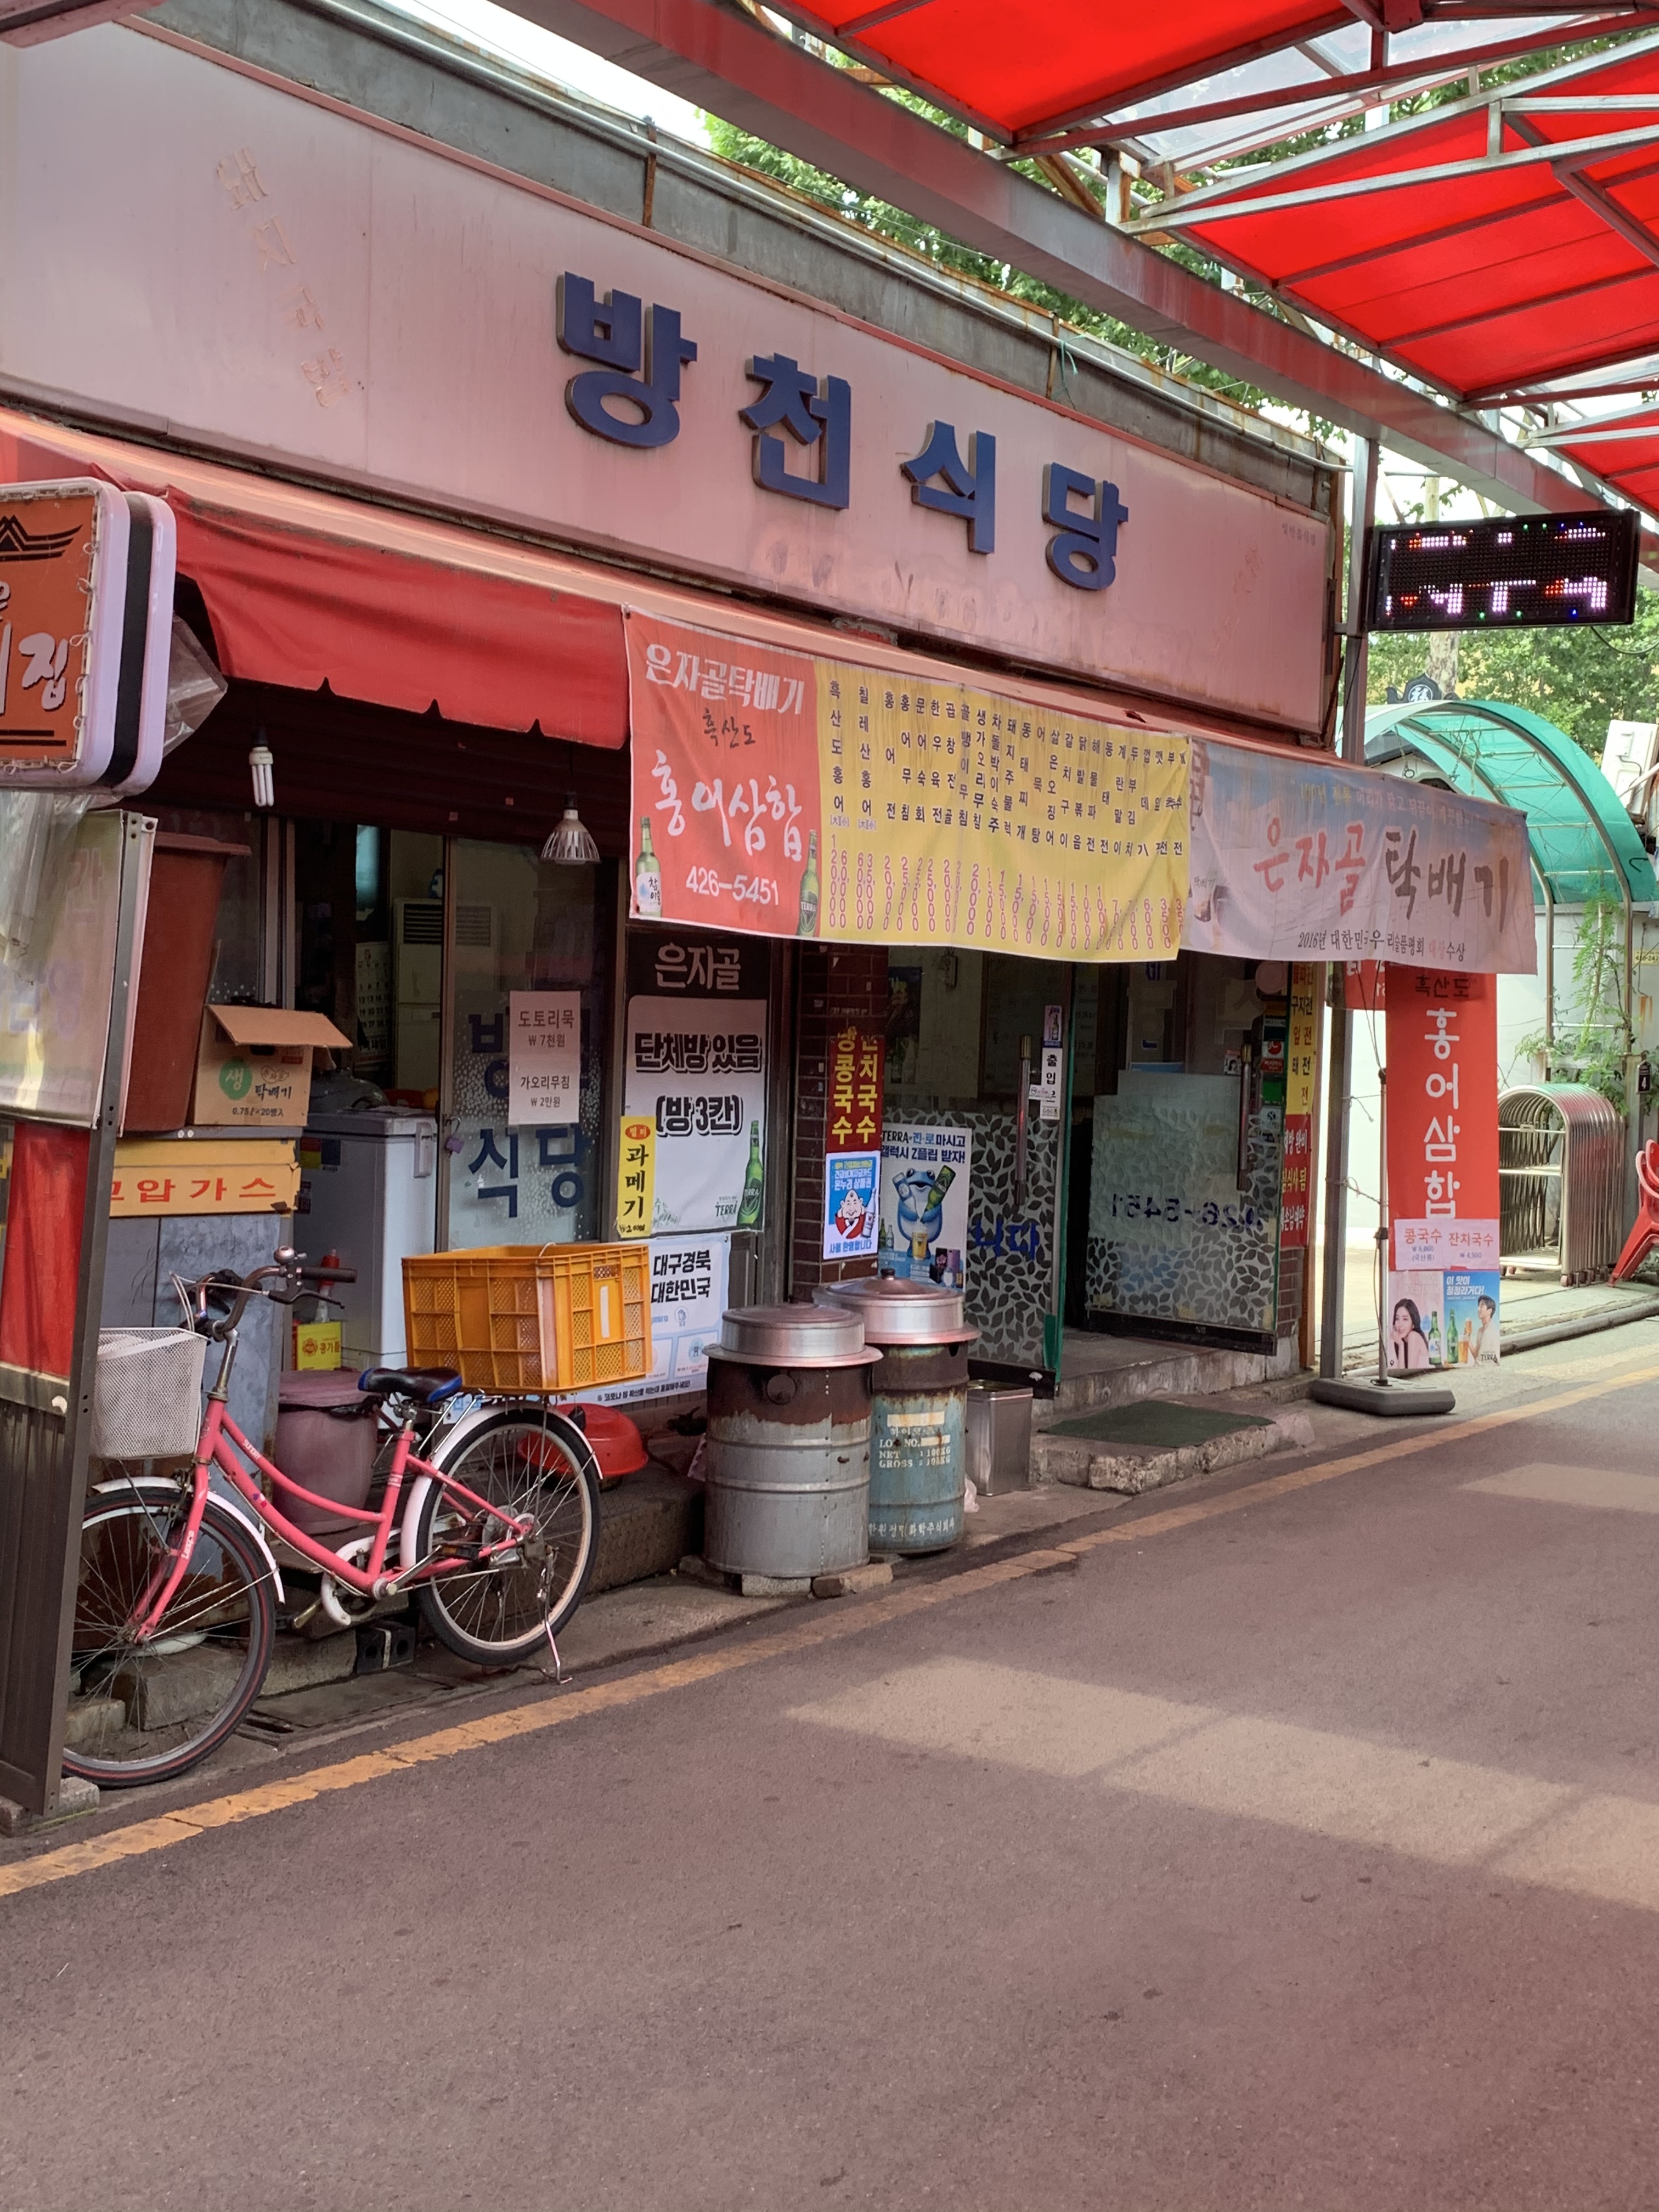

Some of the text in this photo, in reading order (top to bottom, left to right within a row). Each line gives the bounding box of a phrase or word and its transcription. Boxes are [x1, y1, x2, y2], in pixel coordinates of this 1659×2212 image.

[646, 643, 805, 714] 은자골탁배기
[703, 708, 756, 748] 흑산도
[829, 680, 844, 813] 흑산도홍어
[859, 686, 872, 817] 칠레산홍어
[884, 691, 896, 820] 홍어전
[900, 694, 912, 821] 홍어무침
[915, 697, 926, 823] 문어숙회
[930, 699, 943, 823] 한우육전
[973, 708, 986, 830] 생가오리무침
[988, 713, 1002, 833] 차돌박이숙주
[1003, 718, 1017, 837] 돼지주물럭
[1016, 722, 1031, 840] 동태찌개
[1031, 726, 1045, 844] 어묵탕
[1045, 729, 1060, 845] 삶은오징어
[1059, 732, 1074, 848] 갈치구이
[1073, 736, 1087, 850] 닭발볶음
[1086, 739, 1101, 853] 해물파전
[1100, 741, 1114, 855] 동태전
[1114, 744, 1127, 856] 계란말이
[652, 750, 803, 862] 홍어삼합
[1125, 747, 1138, 857] 두부김치
[686, 866, 780, 906] 426-5451
[1253, 816, 1510, 933] 은자골 탁배기
[655, 942, 741, 990] 은자골
[1297, 930, 1327, 951] 2016년
[1415, 975, 1470, 998] 흑산도
[518, 1009, 574, 1029] 도토리묵
[540, 1033, 565, 1048] 7천원
[225, 1067, 244, 1091] 생
[255, 1083, 292, 1101] 탁배기
[520, 1075, 569, 1090] 가오리무침
[540, 1096, 561, 1108] 2만원
[1424, 1007, 1461, 1220] 홍어삼합
[468, 1122, 594, 1218] 식당
[623, 1144, 650, 1220] 과메기
[714, 1200, 738, 1217] TERRA
[651, 1277, 711, 1304] 대한민국
[653, 1250, 711, 1277] 대구경북
[1404, 1228, 1494, 1247] 콩국수 잔치국수
[879, 1450, 900, 1459] NET
[879, 1459, 913, 1469] GROSS
